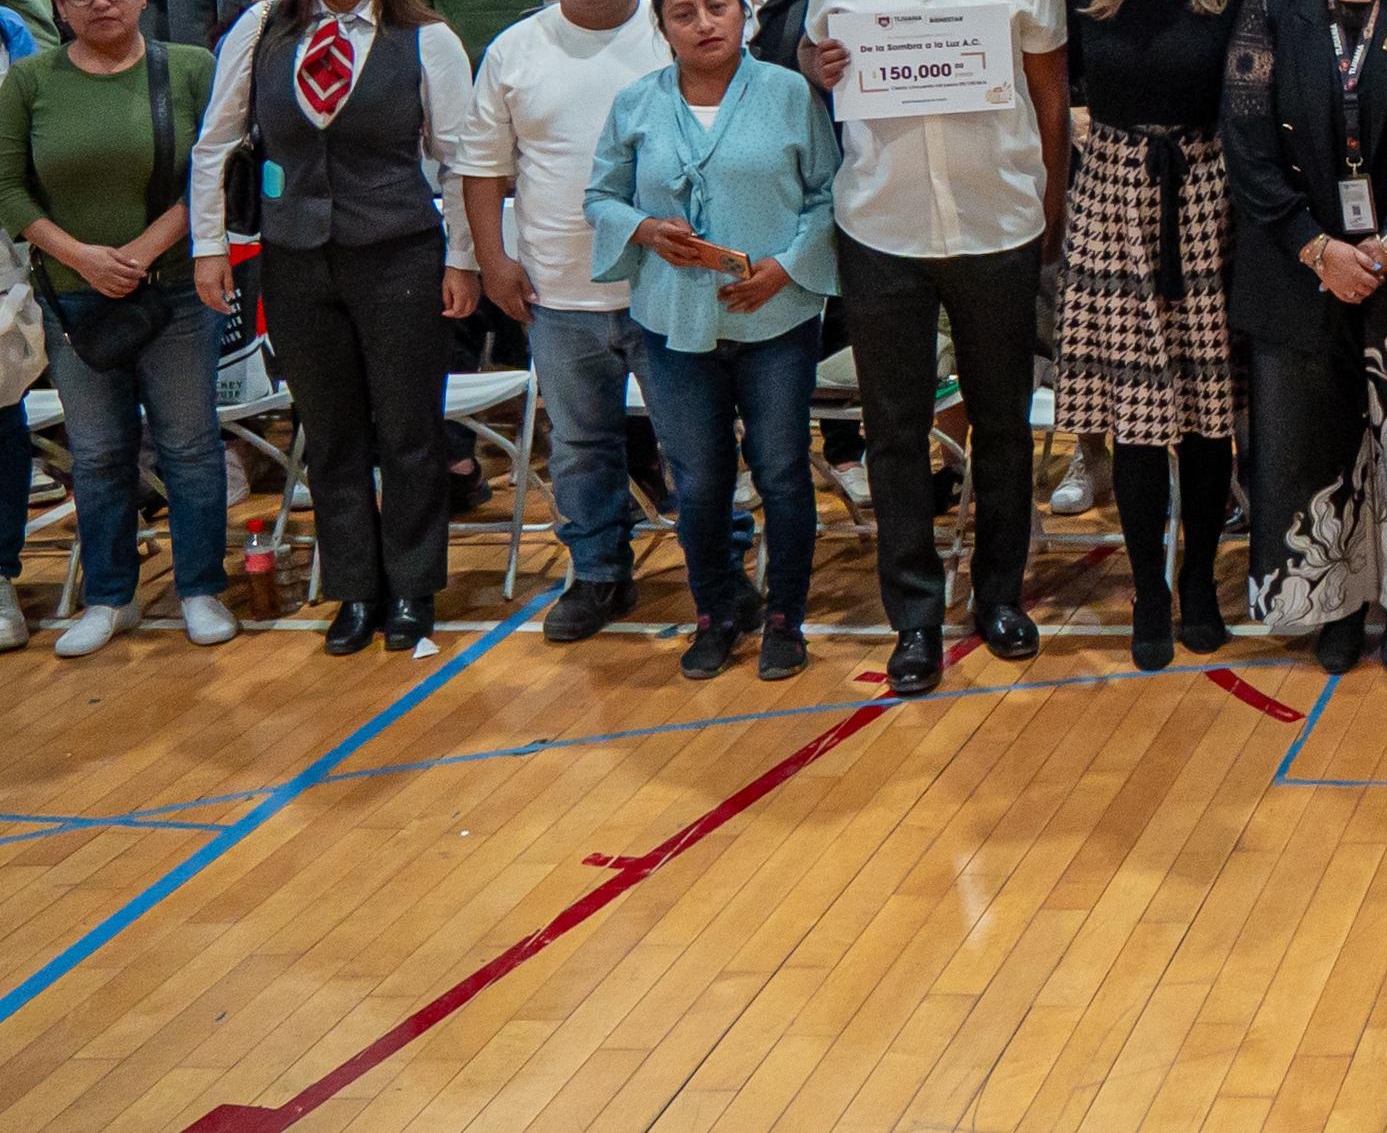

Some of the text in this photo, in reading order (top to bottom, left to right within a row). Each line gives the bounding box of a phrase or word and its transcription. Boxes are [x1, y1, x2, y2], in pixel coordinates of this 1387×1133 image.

[860, 44, 873, 53] De
[875, 43, 885, 52] la
[886, 43, 923, 51] Sombra
[934, 41, 943, 49] la
[946, 40, 960, 48] Luz
[962, 38, 982, 47] A.C.
[879, 63, 952, 82] 150,000
